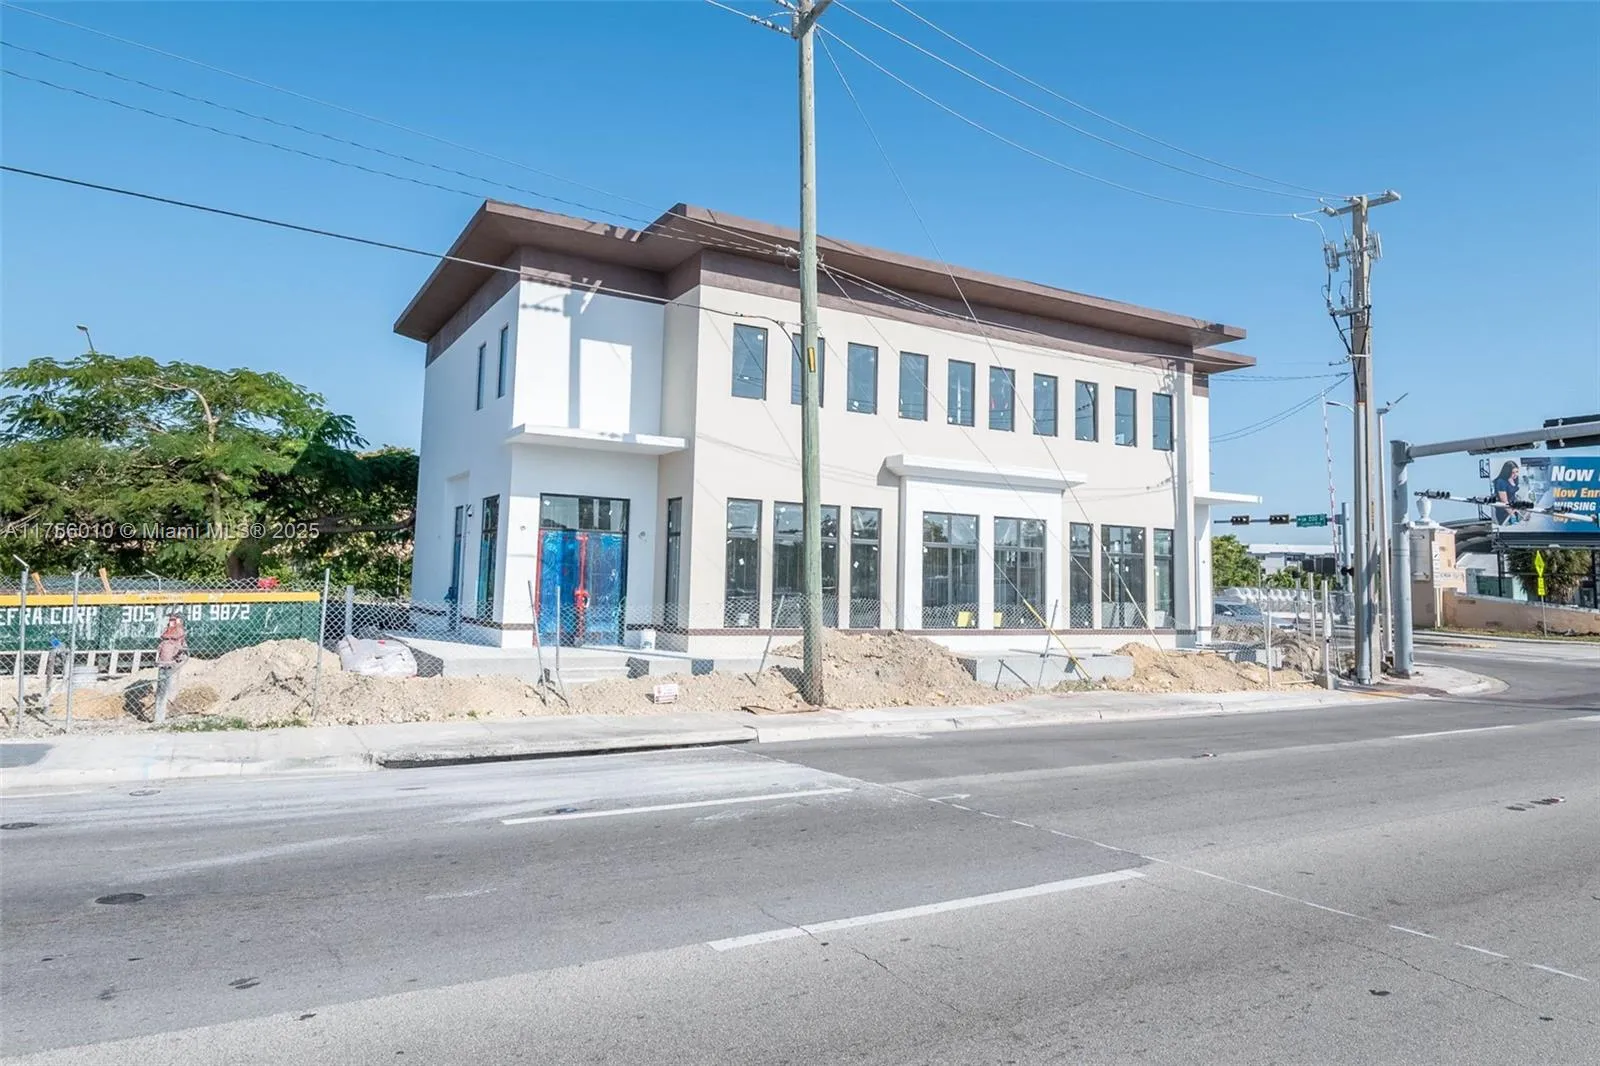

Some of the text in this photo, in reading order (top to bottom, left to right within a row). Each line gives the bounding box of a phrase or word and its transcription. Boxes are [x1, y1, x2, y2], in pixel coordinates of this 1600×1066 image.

[1551, 465, 1594, 482] Now
[1553, 487, 1577, 498] Now
[50, 606, 97, 624] CORP
[121, 605, 155, 622] 305
[209, 604, 250, 620] 9872
